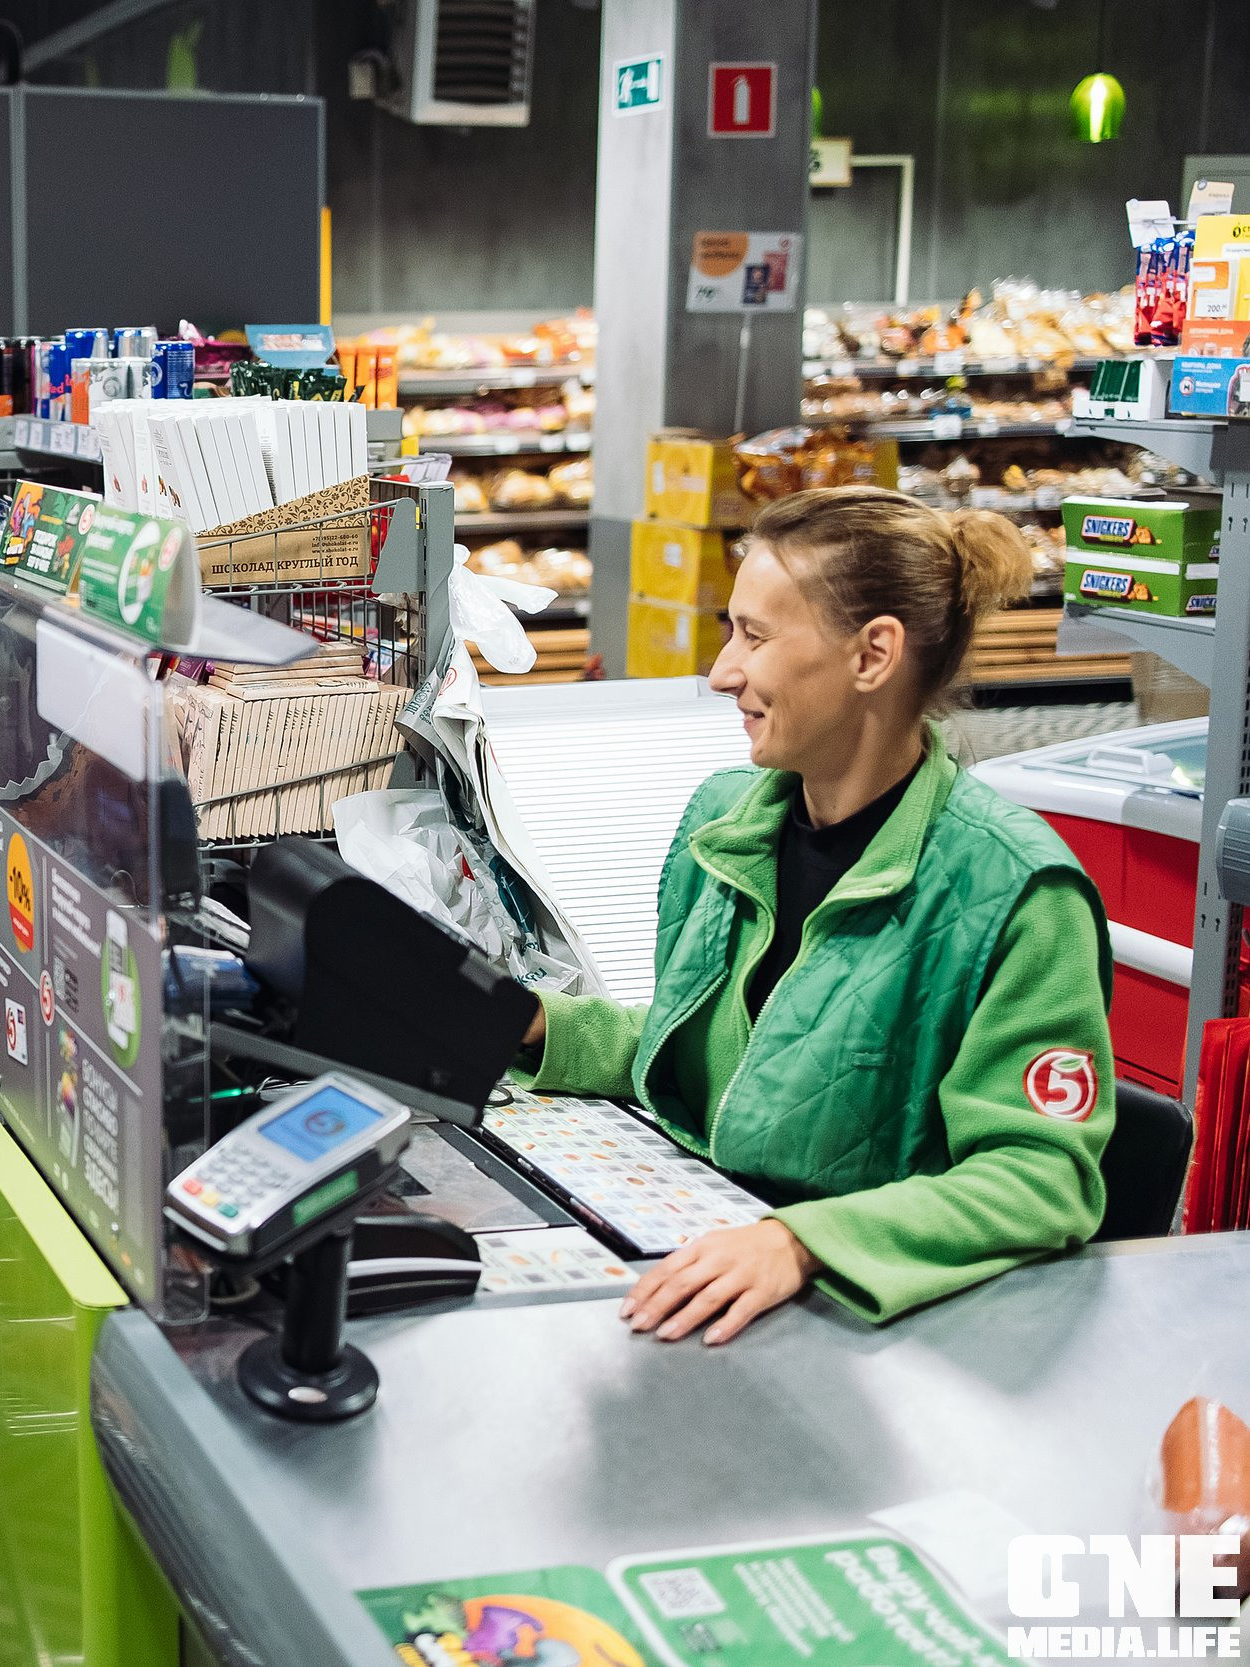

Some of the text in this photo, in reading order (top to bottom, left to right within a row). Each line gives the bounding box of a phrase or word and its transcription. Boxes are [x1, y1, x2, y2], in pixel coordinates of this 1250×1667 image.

[1085, 518, 1130, 536] SNICKERS
[212, 555, 359, 574] ШОКОЛАД КРУГЛЫЙ ГОД
[1084, 574, 1128, 592] SNICKERS
